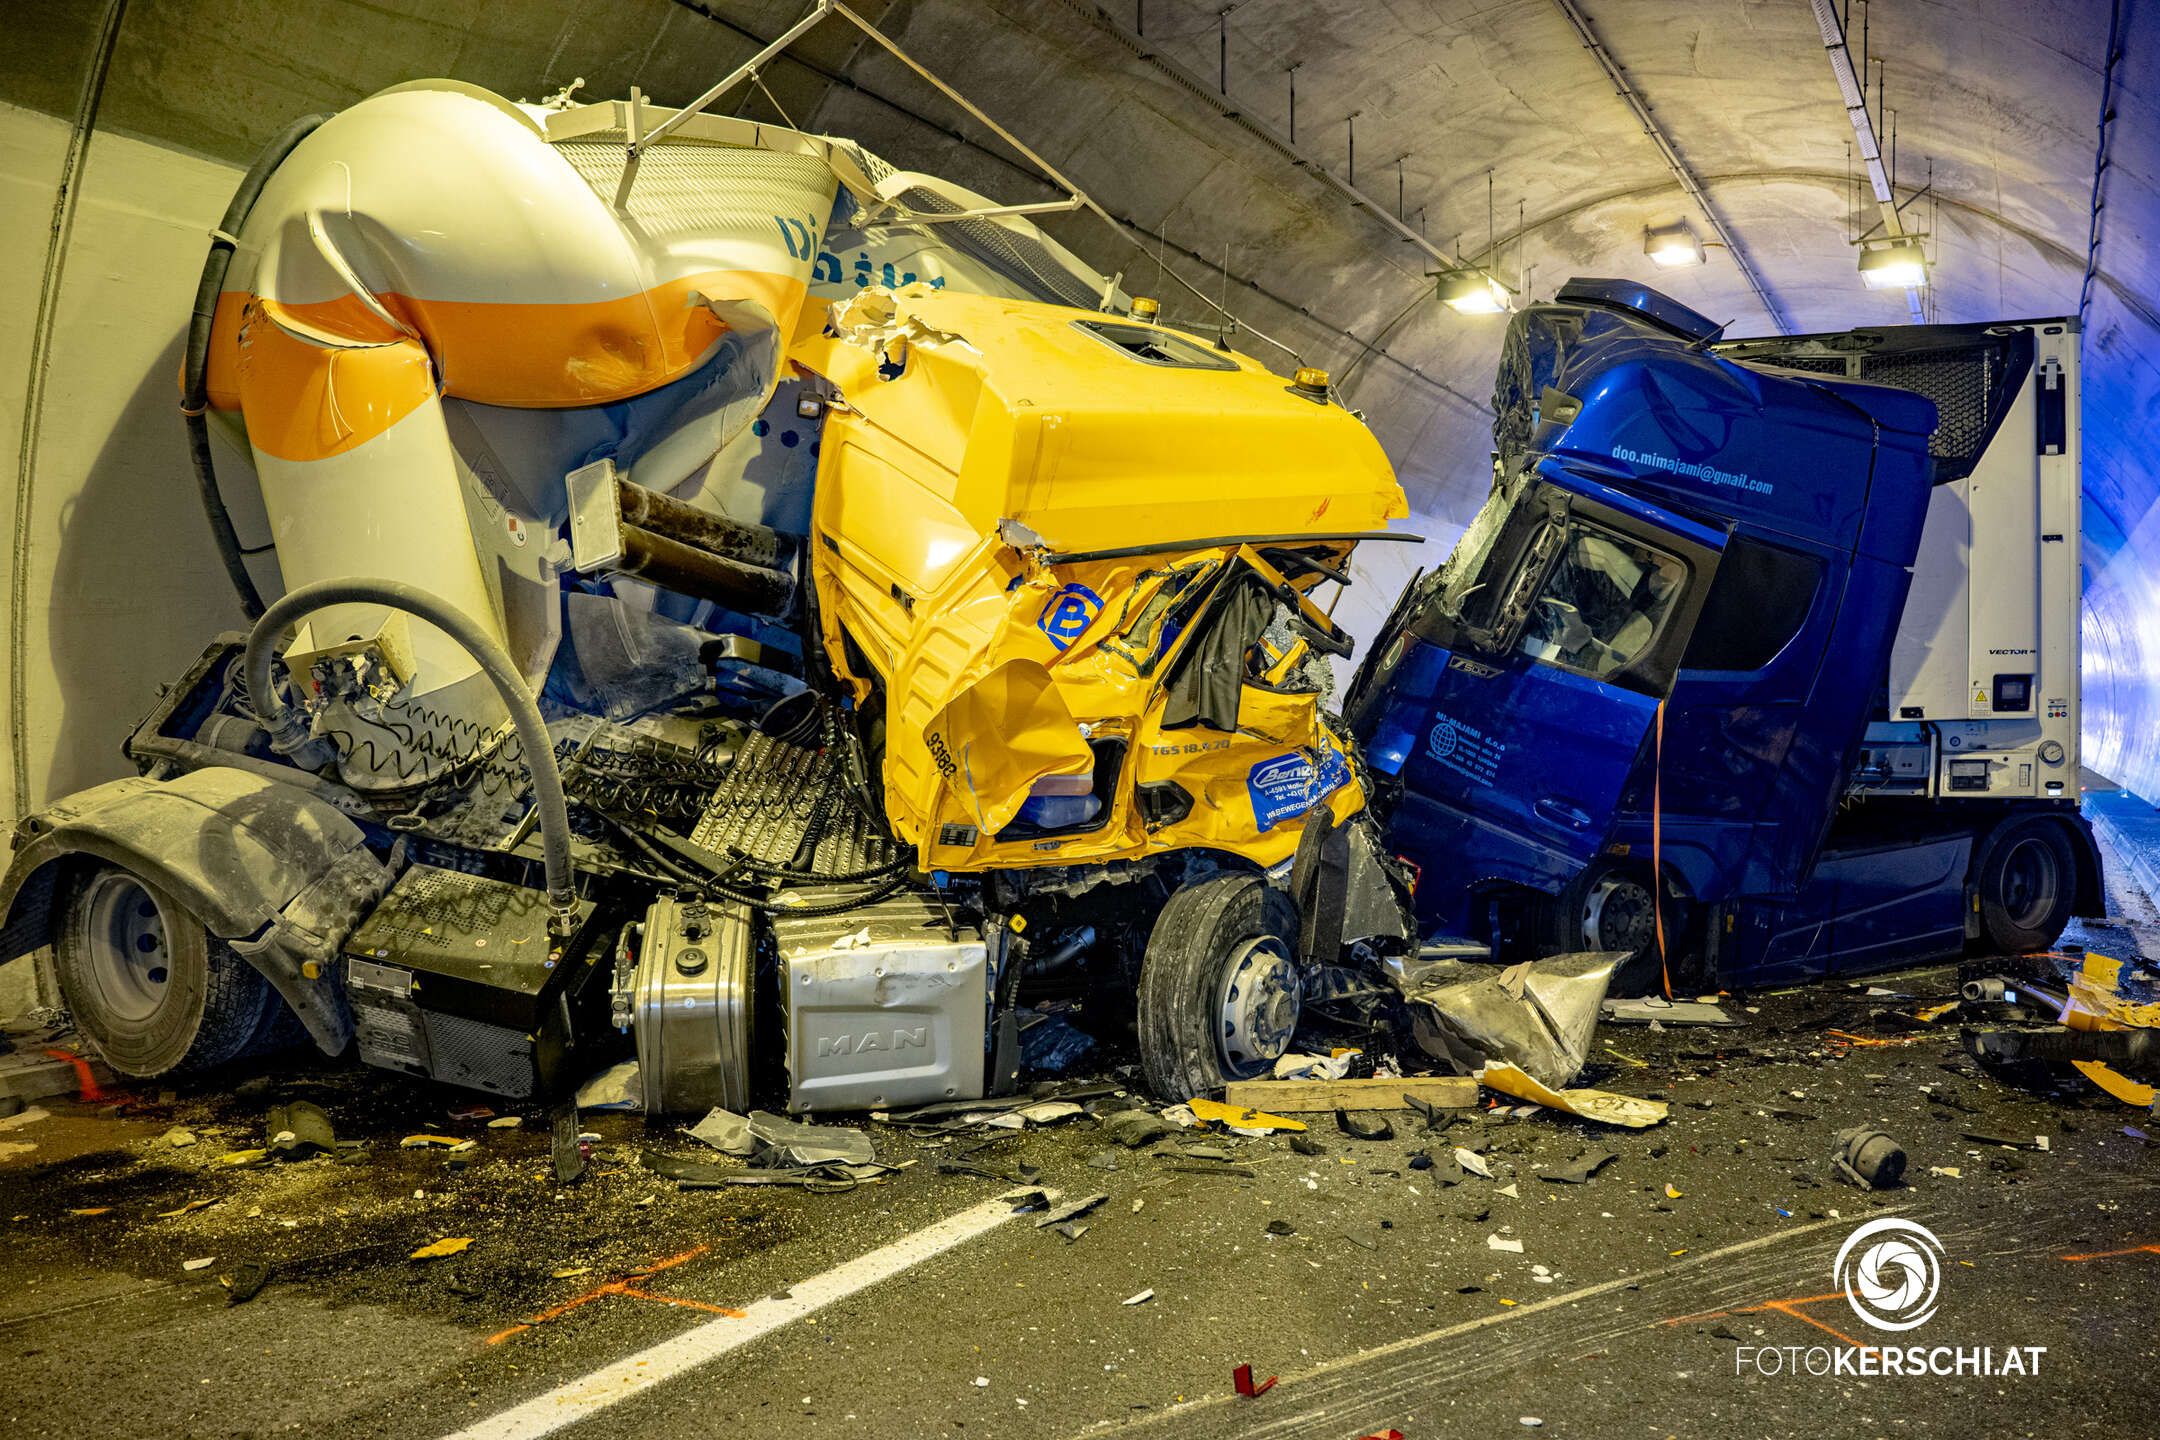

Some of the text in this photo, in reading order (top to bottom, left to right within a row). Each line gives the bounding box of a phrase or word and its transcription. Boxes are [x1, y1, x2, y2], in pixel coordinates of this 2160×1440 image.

[1611, 444, 1774, 495] doo.mimajami@gmail.com
[1152, 745, 1180, 756] TGS
[818, 1027, 927, 1058] MAN
